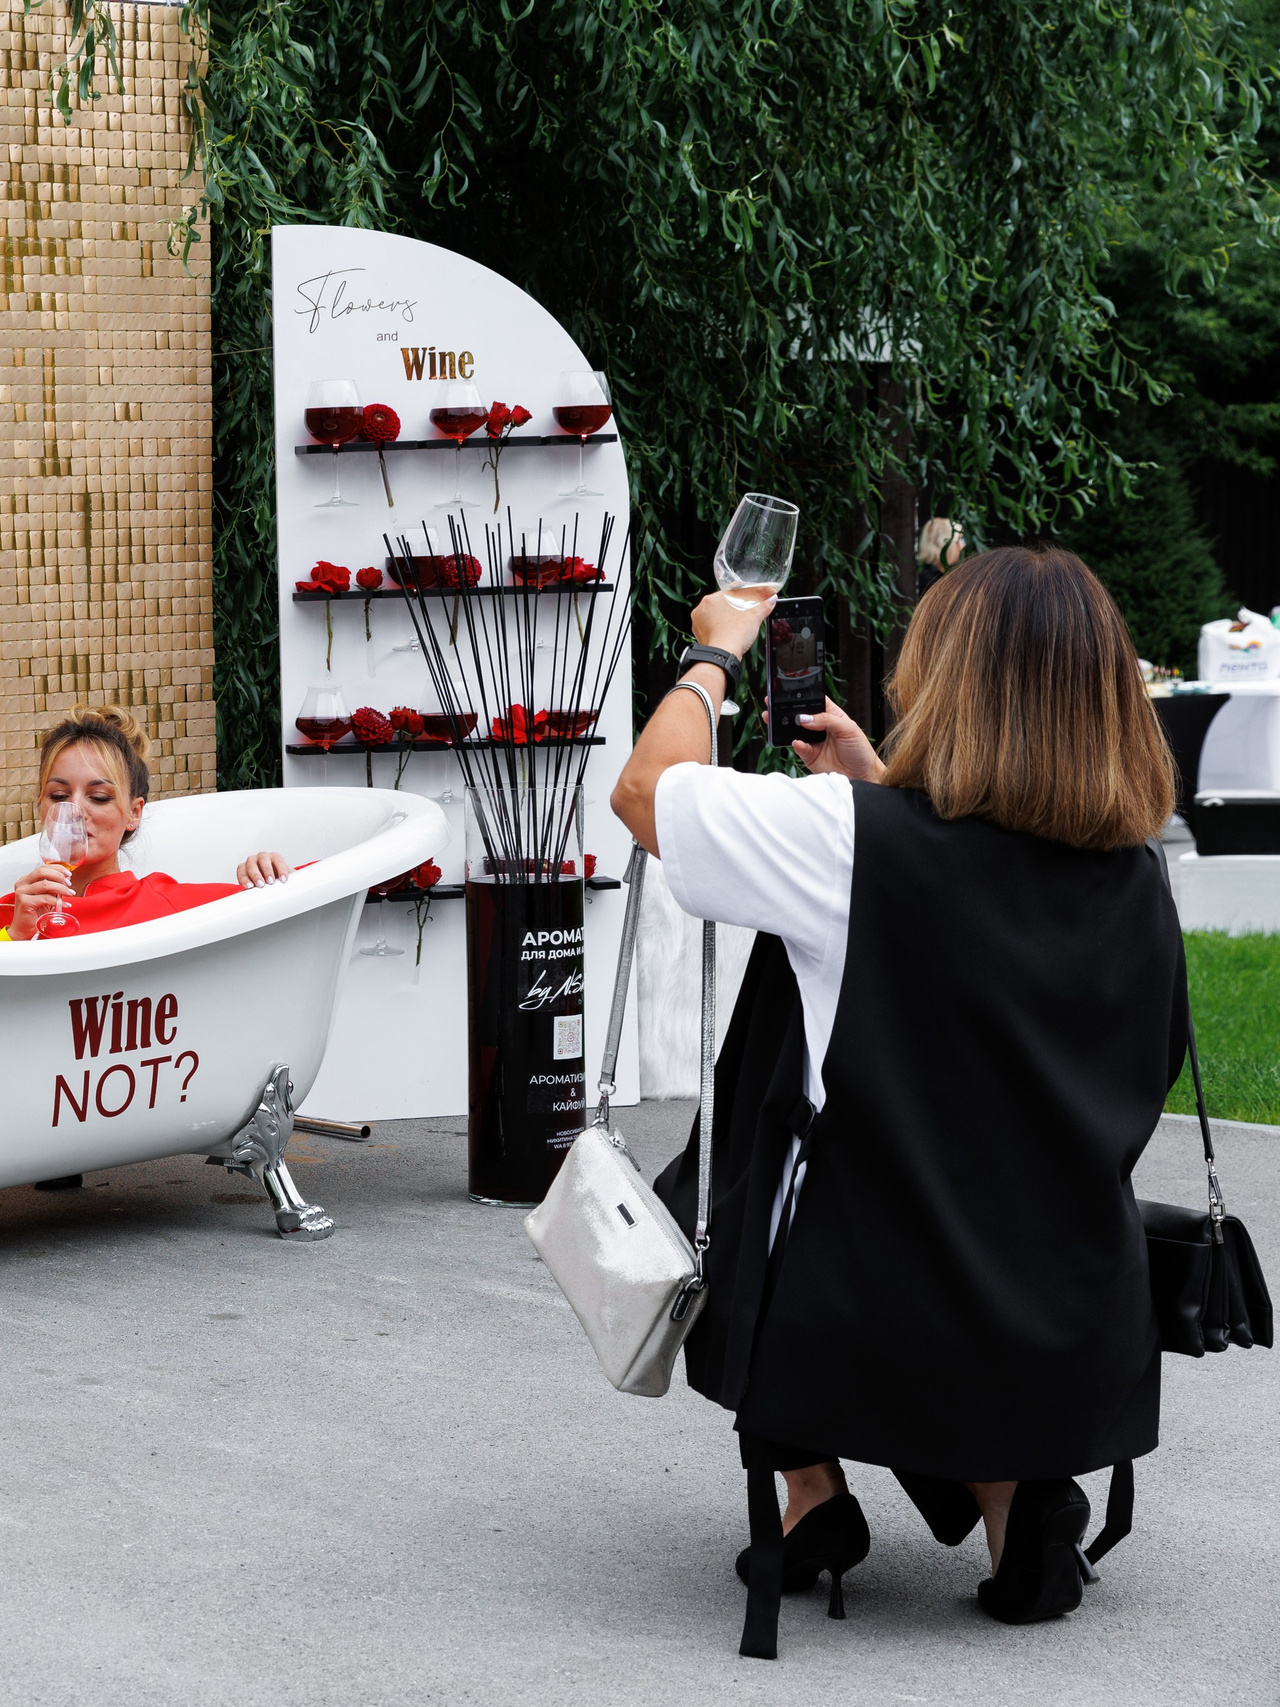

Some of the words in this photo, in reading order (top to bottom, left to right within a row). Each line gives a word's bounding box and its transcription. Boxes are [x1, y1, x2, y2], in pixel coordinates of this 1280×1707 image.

[294, 267, 419, 334] Flowers
[376, 330, 399, 342] and
[400, 346, 475, 381] Wine
[521, 950, 546, 961] ДЛЯ
[548, 947, 576, 960] ДОМА
[518, 969, 554, 1010] by
[68, 991, 178, 1060] Wine
[51, 1050, 200, 1127] NOT?
[570, 1087, 577, 1097] &
